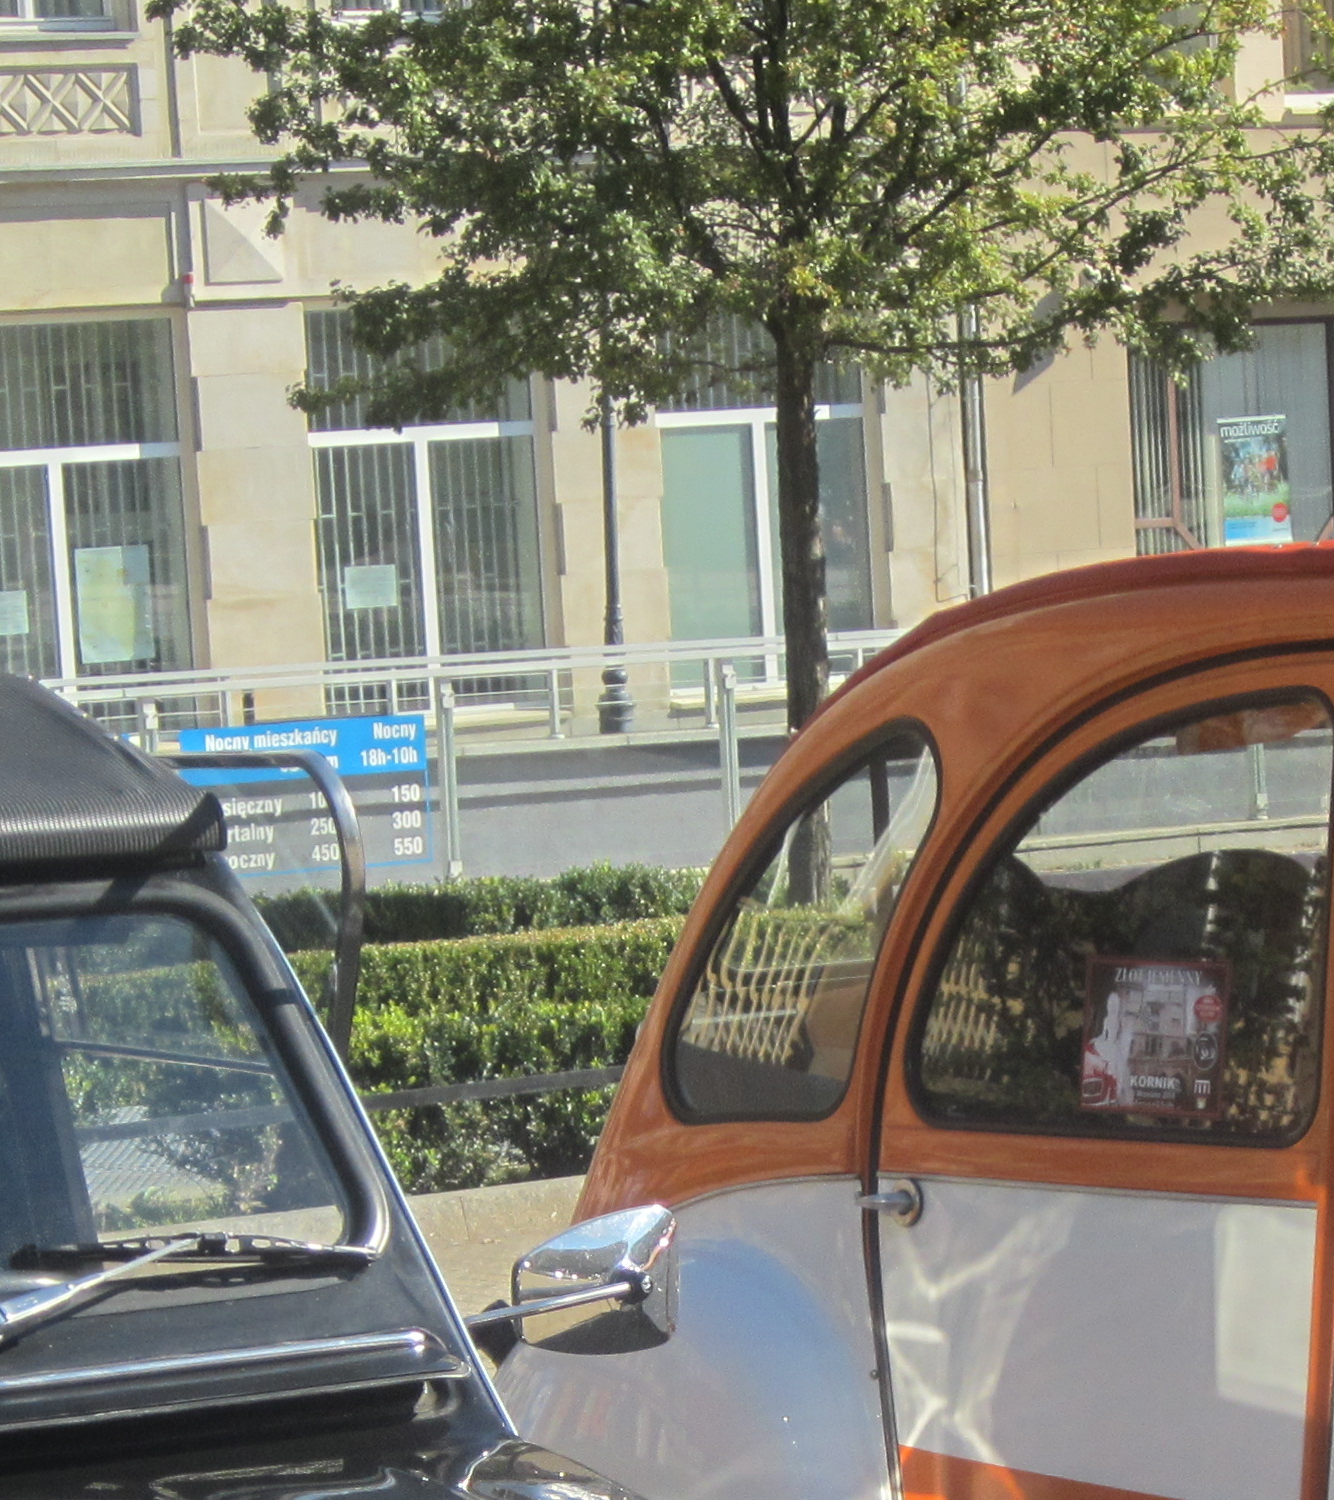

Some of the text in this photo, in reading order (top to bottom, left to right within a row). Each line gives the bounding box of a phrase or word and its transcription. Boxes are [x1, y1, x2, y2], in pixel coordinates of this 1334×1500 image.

[1220, 421, 1279, 438] możliwość
[254, 726, 338, 747] mieszkańcy
[373, 722, 416, 741] Nocny
[360, 746, 419, 766] 18h-10h
[392, 784, 421, 803] 150
[222, 797, 283, 819] sięczny
[392, 810, 422, 830] 300
[227, 822, 275, 845] rtalny
[312, 842, 340, 862] 450
[394, 836, 423, 856] 550
